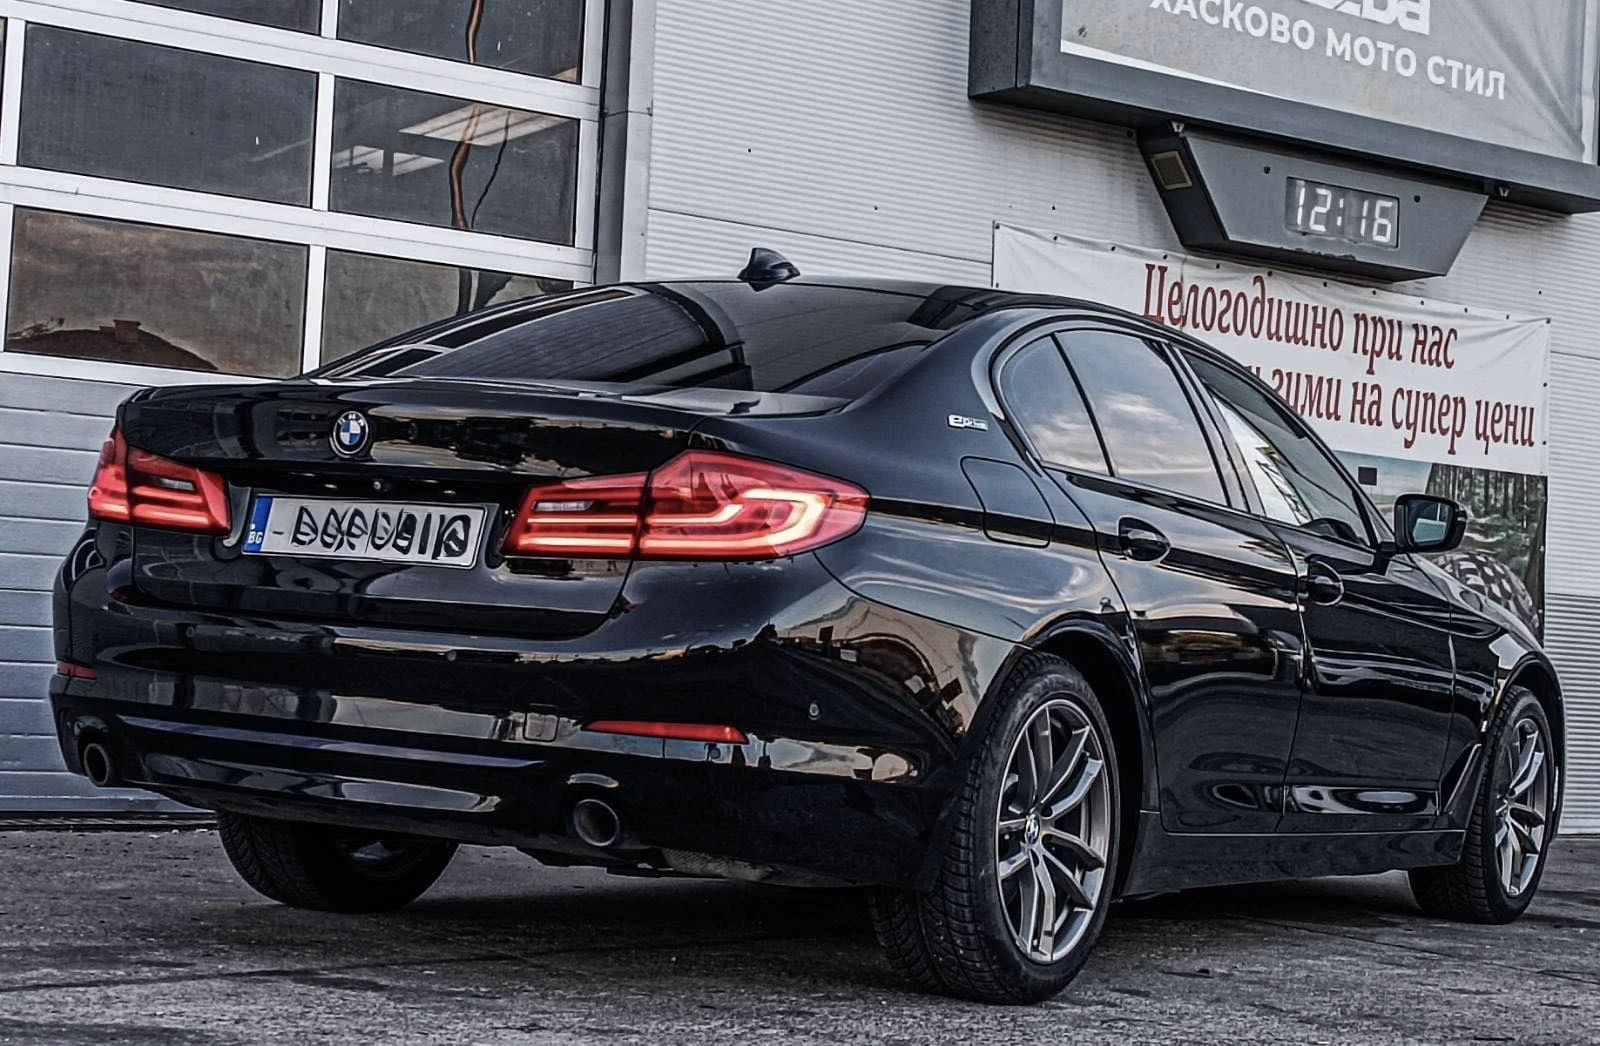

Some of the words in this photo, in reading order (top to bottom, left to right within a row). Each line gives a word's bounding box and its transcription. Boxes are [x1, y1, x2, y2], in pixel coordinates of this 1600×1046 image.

[1326, 27, 1417, 77] МОТО
[1427, 55, 1506, 100] СТИЛ
[1296, 180, 1393, 243] 12:16
[1143, 264, 1344, 352] Целогодишно
[1352, 312, 1403, 376] при
[1411, 321, 1459, 370] нас
[1350, 379, 1383, 428] на
[1391, 385, 1467, 456] супер
[1475, 399, 1535, 456] цени
[248, 530, 263, 544] BG
